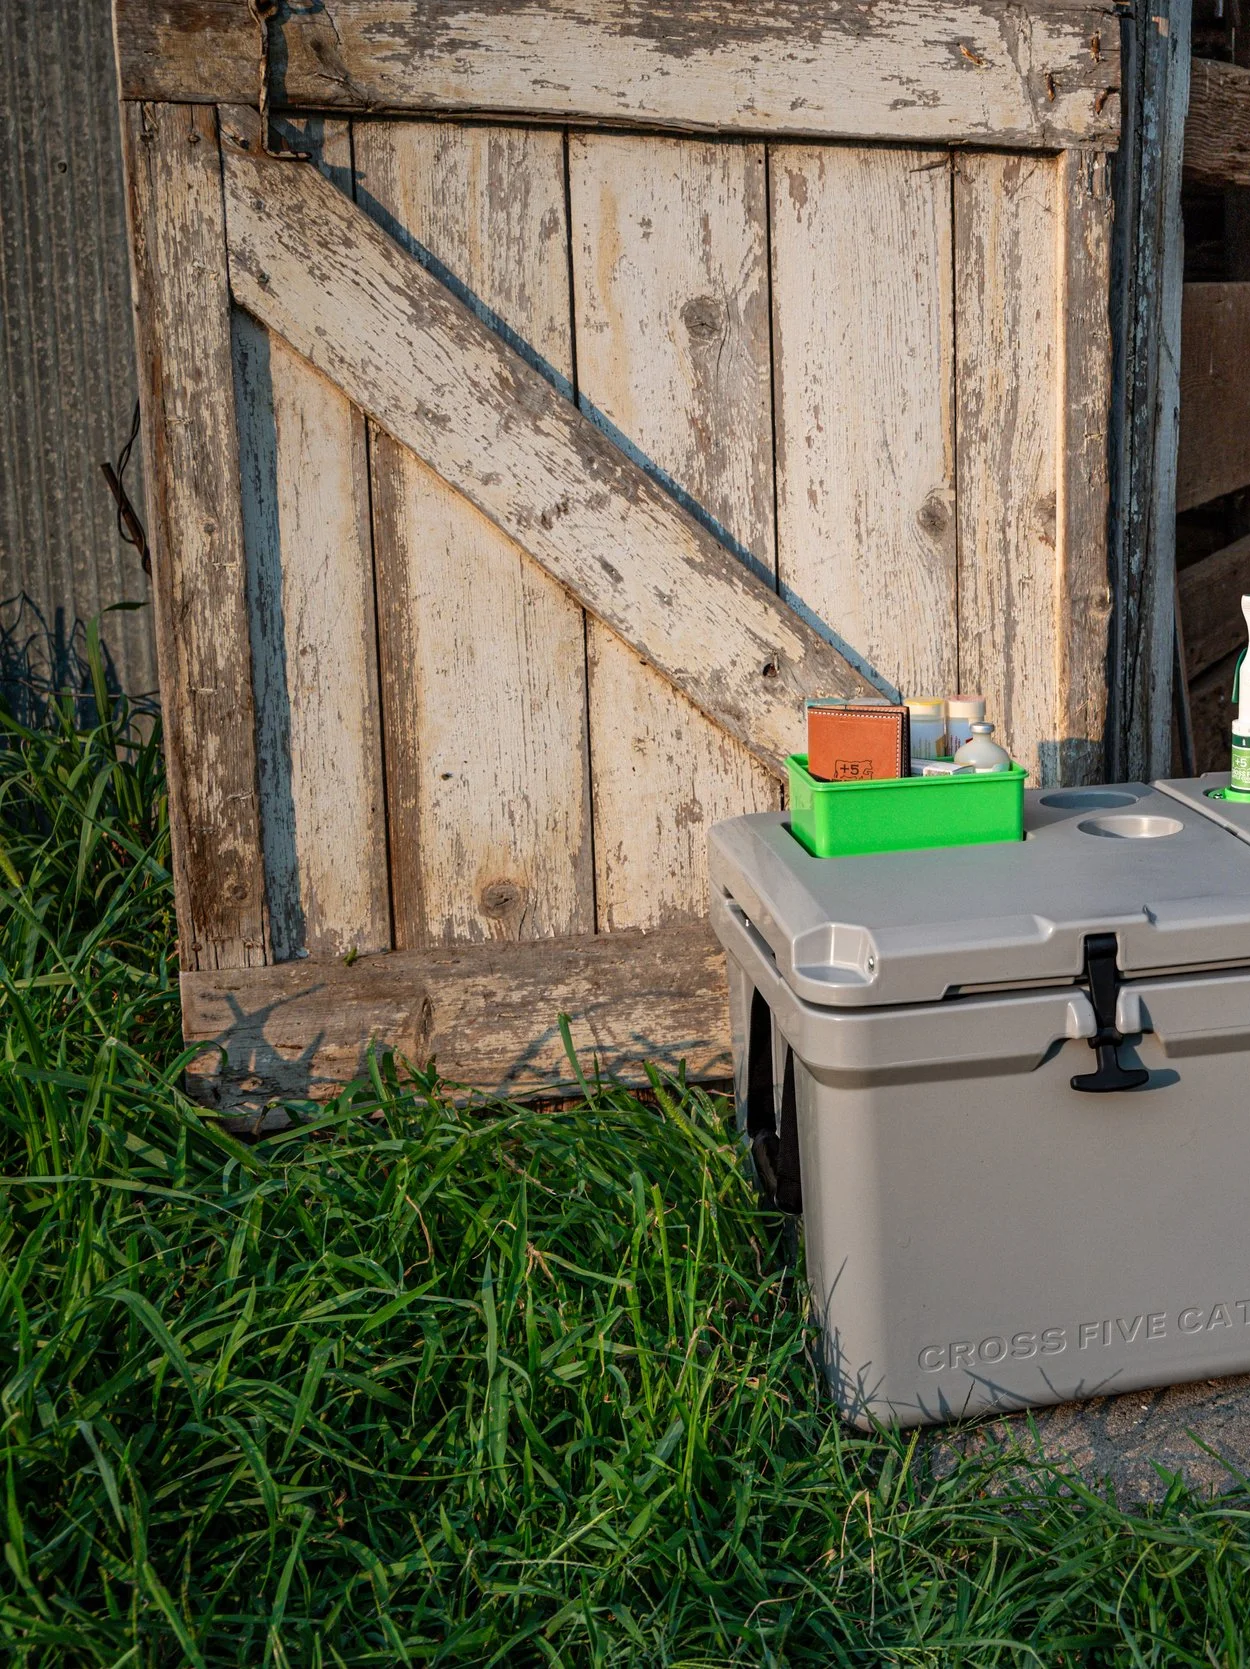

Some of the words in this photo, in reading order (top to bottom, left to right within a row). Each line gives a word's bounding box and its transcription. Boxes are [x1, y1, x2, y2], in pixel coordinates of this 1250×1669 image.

[840, 764, 859, 775] +5
[918, 1327, 1067, 1373] CROSS
[1078, 1311, 1167, 1350] FIVE
